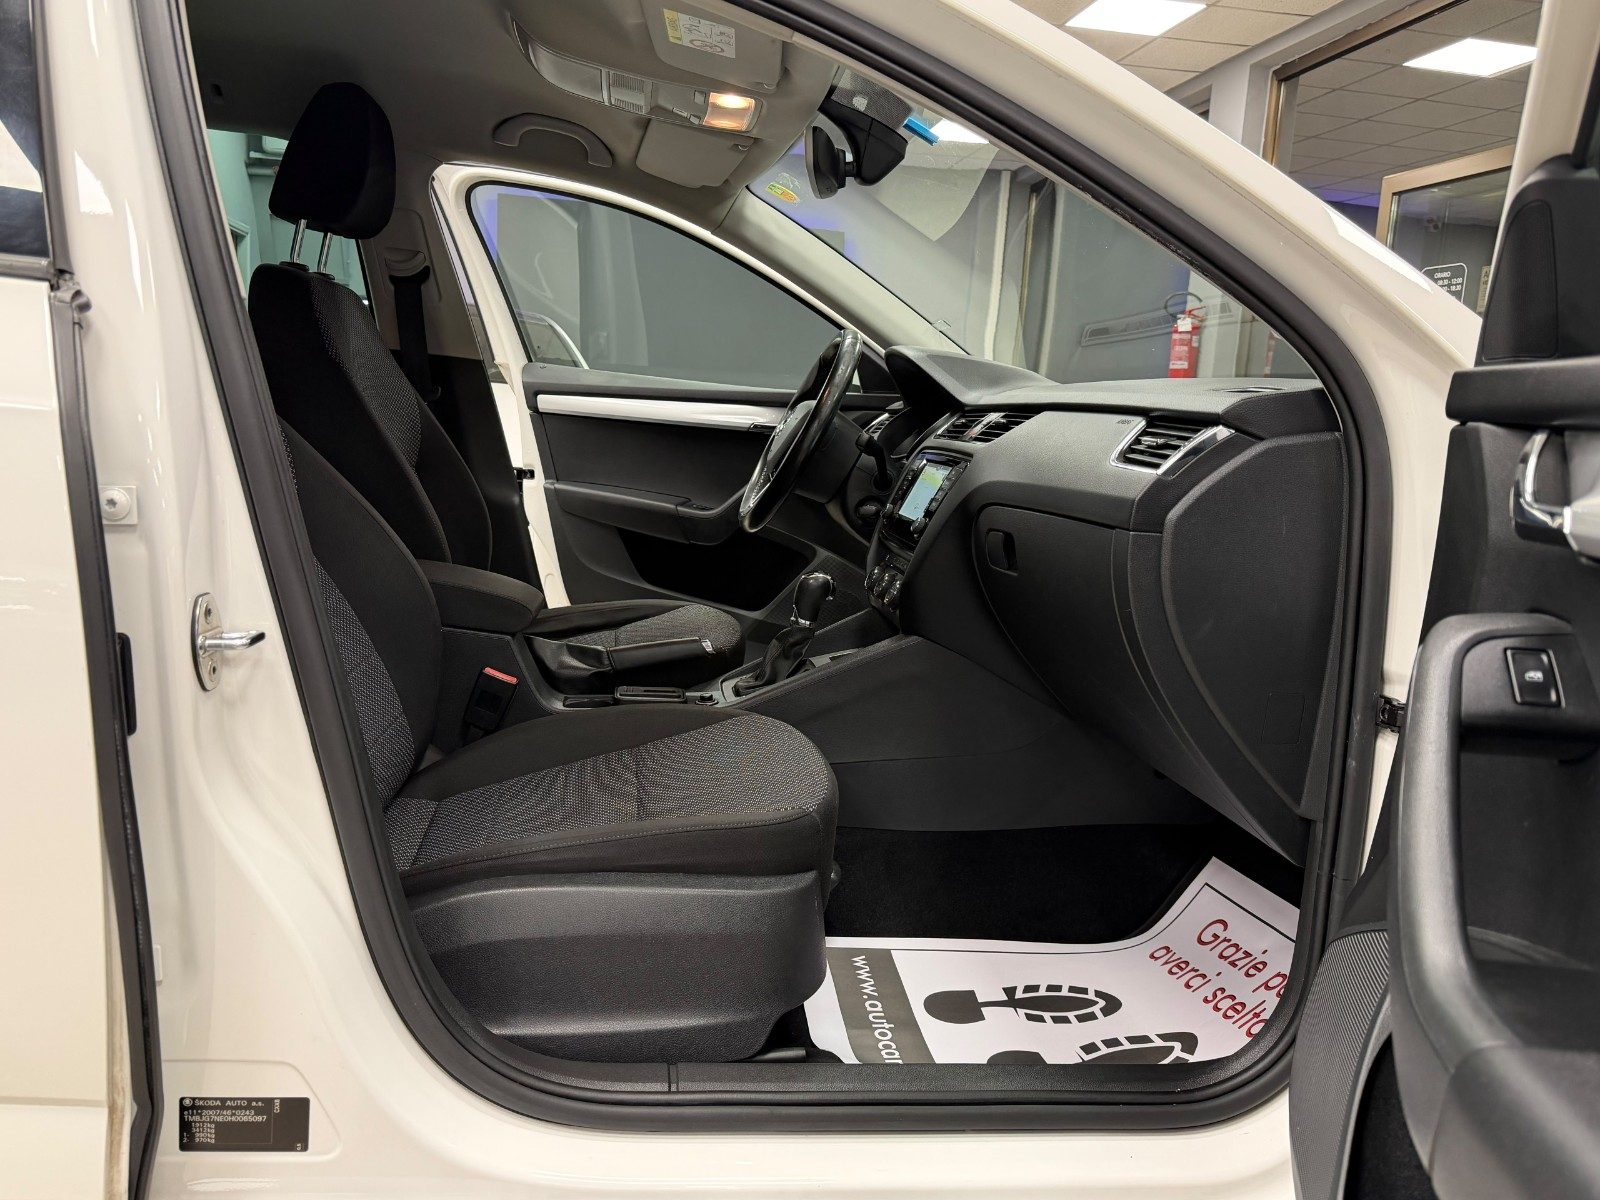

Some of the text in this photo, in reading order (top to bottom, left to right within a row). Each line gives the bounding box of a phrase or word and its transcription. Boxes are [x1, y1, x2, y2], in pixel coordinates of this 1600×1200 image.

[1149, 945, 1222, 993] averci
[1196, 918, 1269, 978] Grazie
[194, 1098, 221, 1107] ŠKODA
